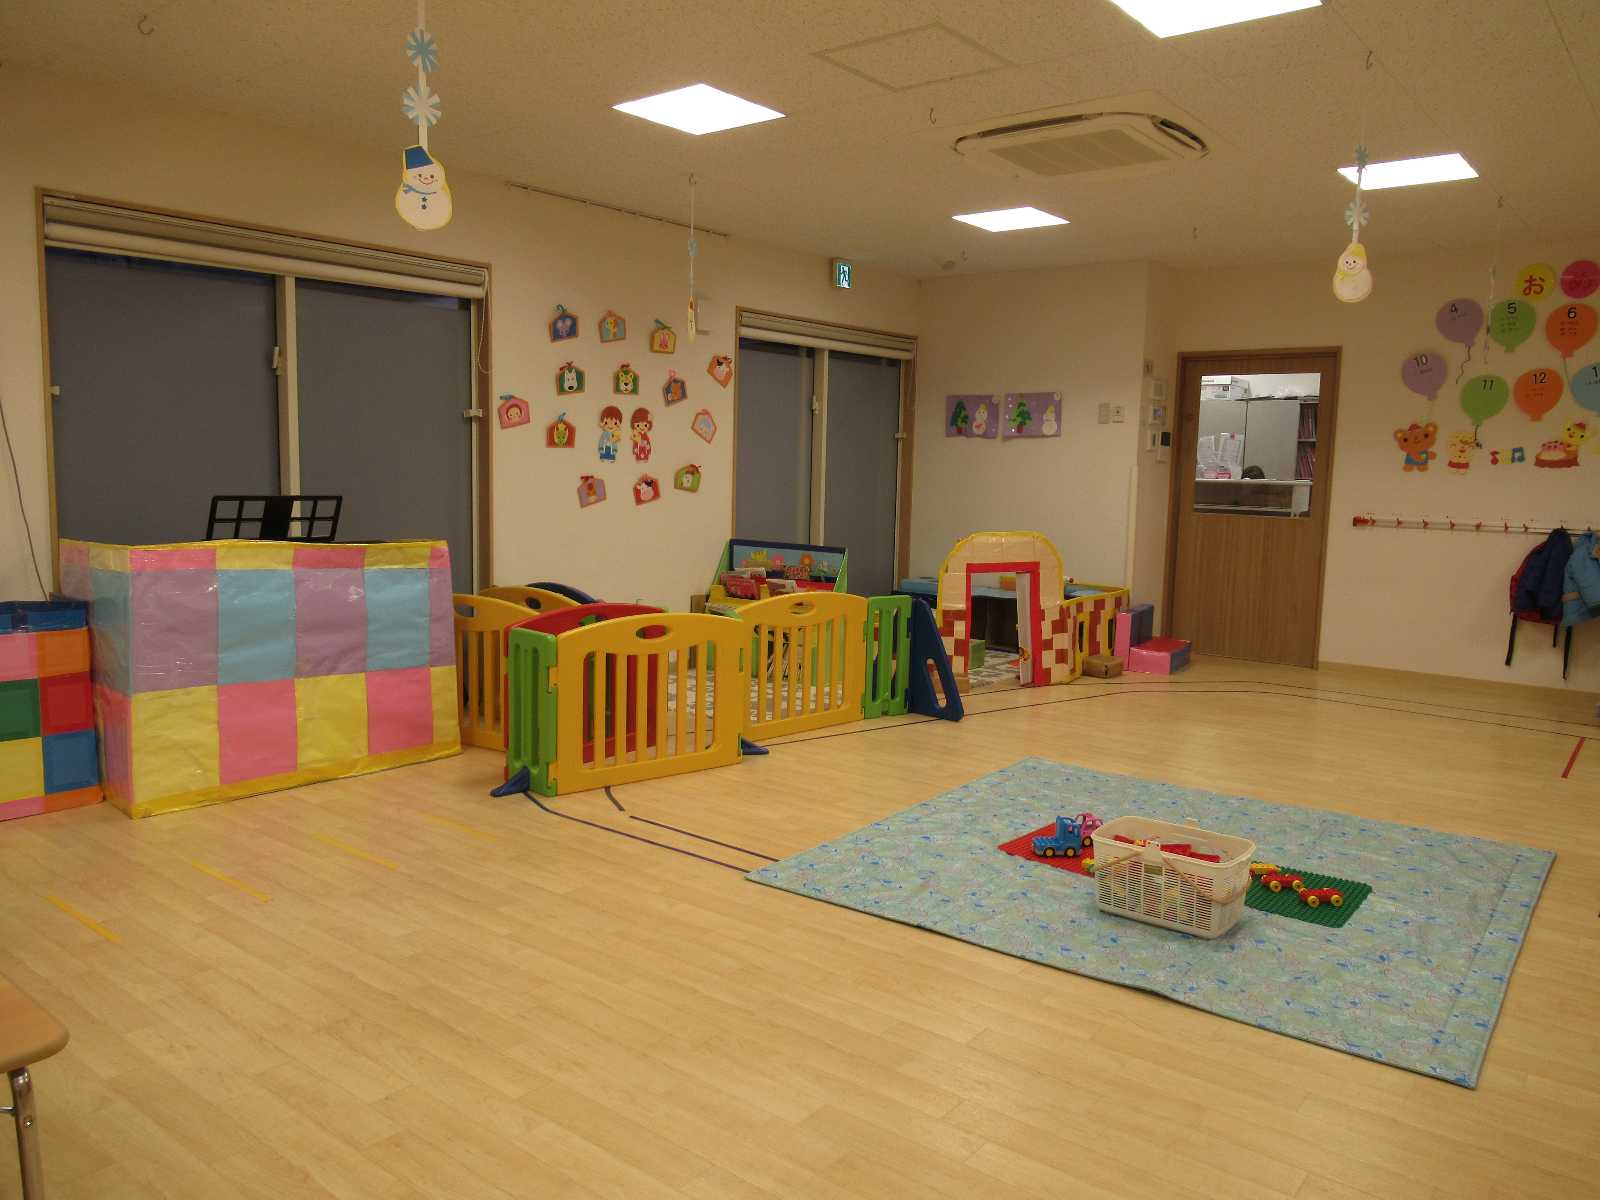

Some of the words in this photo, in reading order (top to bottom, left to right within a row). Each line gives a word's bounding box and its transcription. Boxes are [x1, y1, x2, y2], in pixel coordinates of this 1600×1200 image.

[1523, 275, 1545, 296] お
[1507, 302, 1517, 314] 5
[1567, 307, 1577, 319] 6
[1413, 354, 1428, 367] 10
[1532, 372, 1546, 384] 12
[1481, 379, 1494, 391] 11
